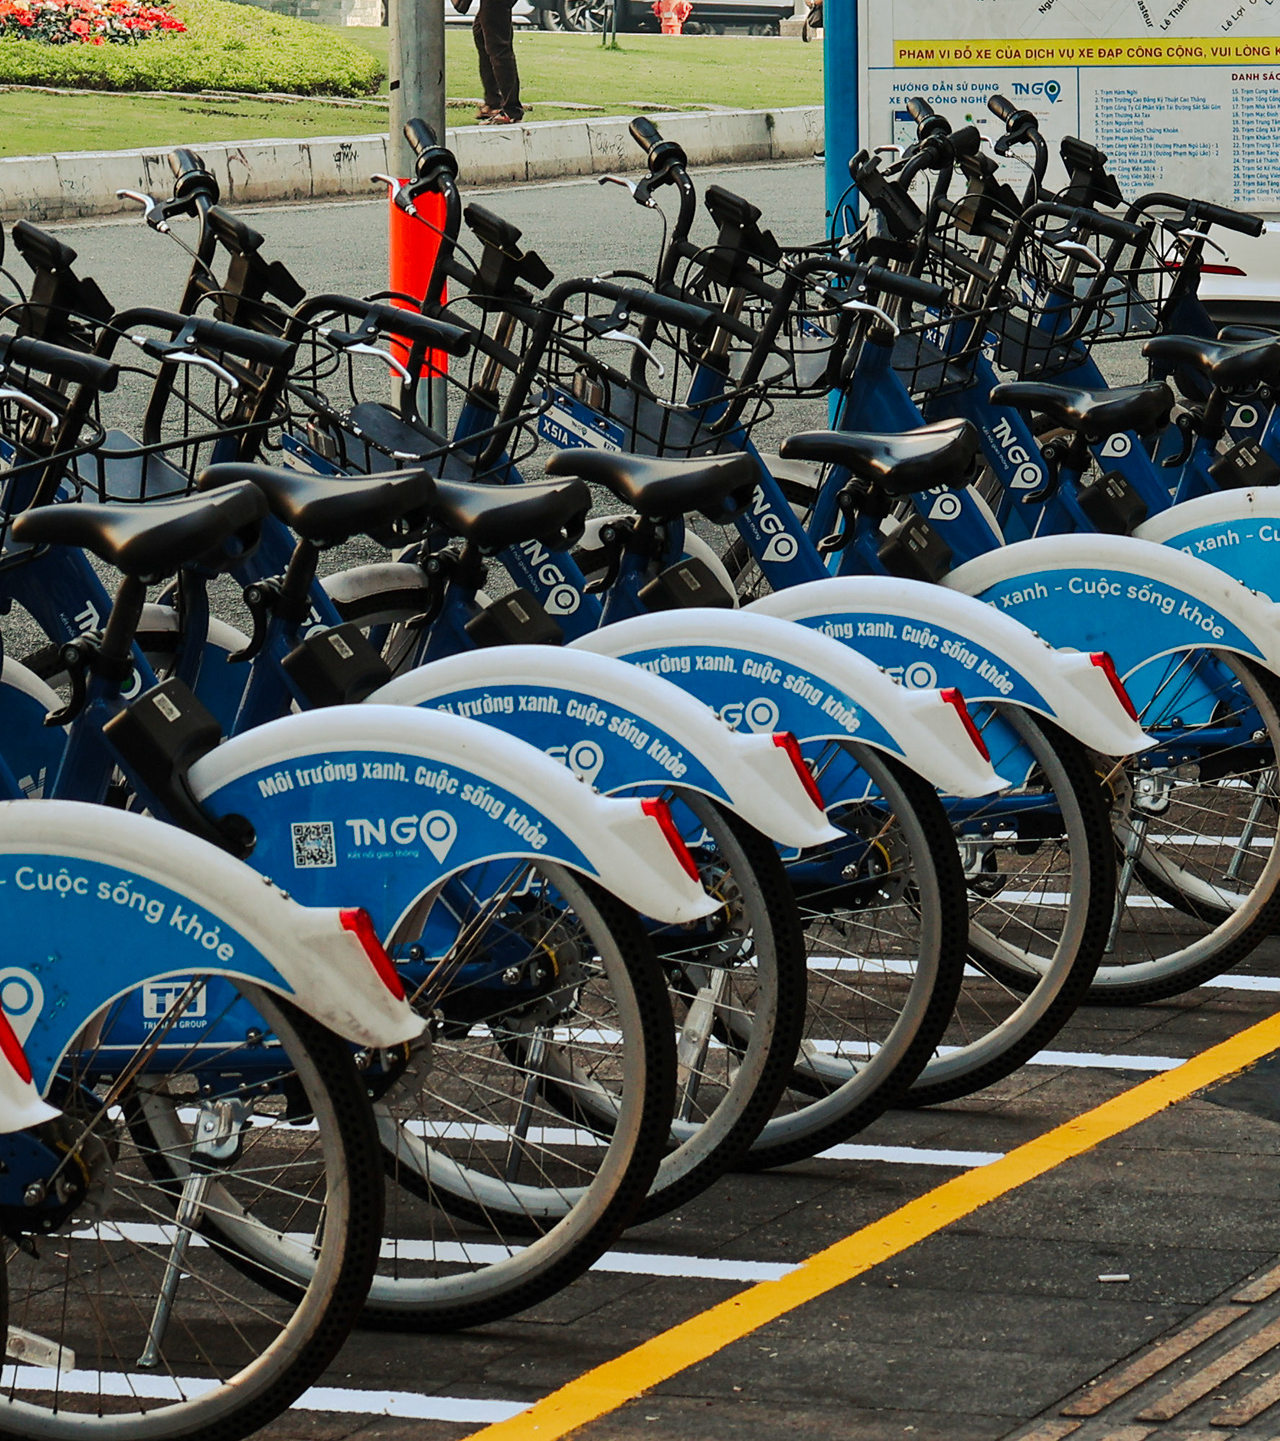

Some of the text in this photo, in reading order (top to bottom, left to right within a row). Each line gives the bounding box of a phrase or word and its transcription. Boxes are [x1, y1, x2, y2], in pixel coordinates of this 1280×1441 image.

[899, 49, 935, 61] PHẠM
[939, 49, 950, 59] VI
[976, 49, 992, 59] XE
[996, 45, 1021, 59] CỦA
[1025, 48, 1054, 61] DỊCH
[1058, 48, 1074, 61] VỤ
[1078, 48, 1094, 58] XE
[1098, 48, 1122, 60] ĐẠP
[1127, 45, 1162, 58] CÔNG
[1166, 45, 1206, 59] CỘNG,
[1211, 47, 1231, 57] VUI
[1235, 44, 1270, 57] LÒNG
[1232, 73, 1260, 81] DANH
[889, 97, 901, 105] XE
[927, 94, 958, 104] CÔNG
[892, 80, 999, 93] HƯỚNG DẪN SỬ DỤNG
[1195, 529, 1240, 555] xanh
[1001, 576, 1226, 640] xanh Cuộc sống khỏe
[857, 621, 1015, 696] xanh. Cuộc sống khỏe
[695, 653, 862, 734] xanh. Cuộc sống khỏe
[457, 692, 689, 780] trường xanh. Cuộc sống khỏe
[258, 759, 550, 851] Môi trường xanh. Cuộc sống khỏe
[14, 866, 89, 901] Cuộc
[96, 877, 165, 925] sống
[168, 905, 236, 962] khỏe
